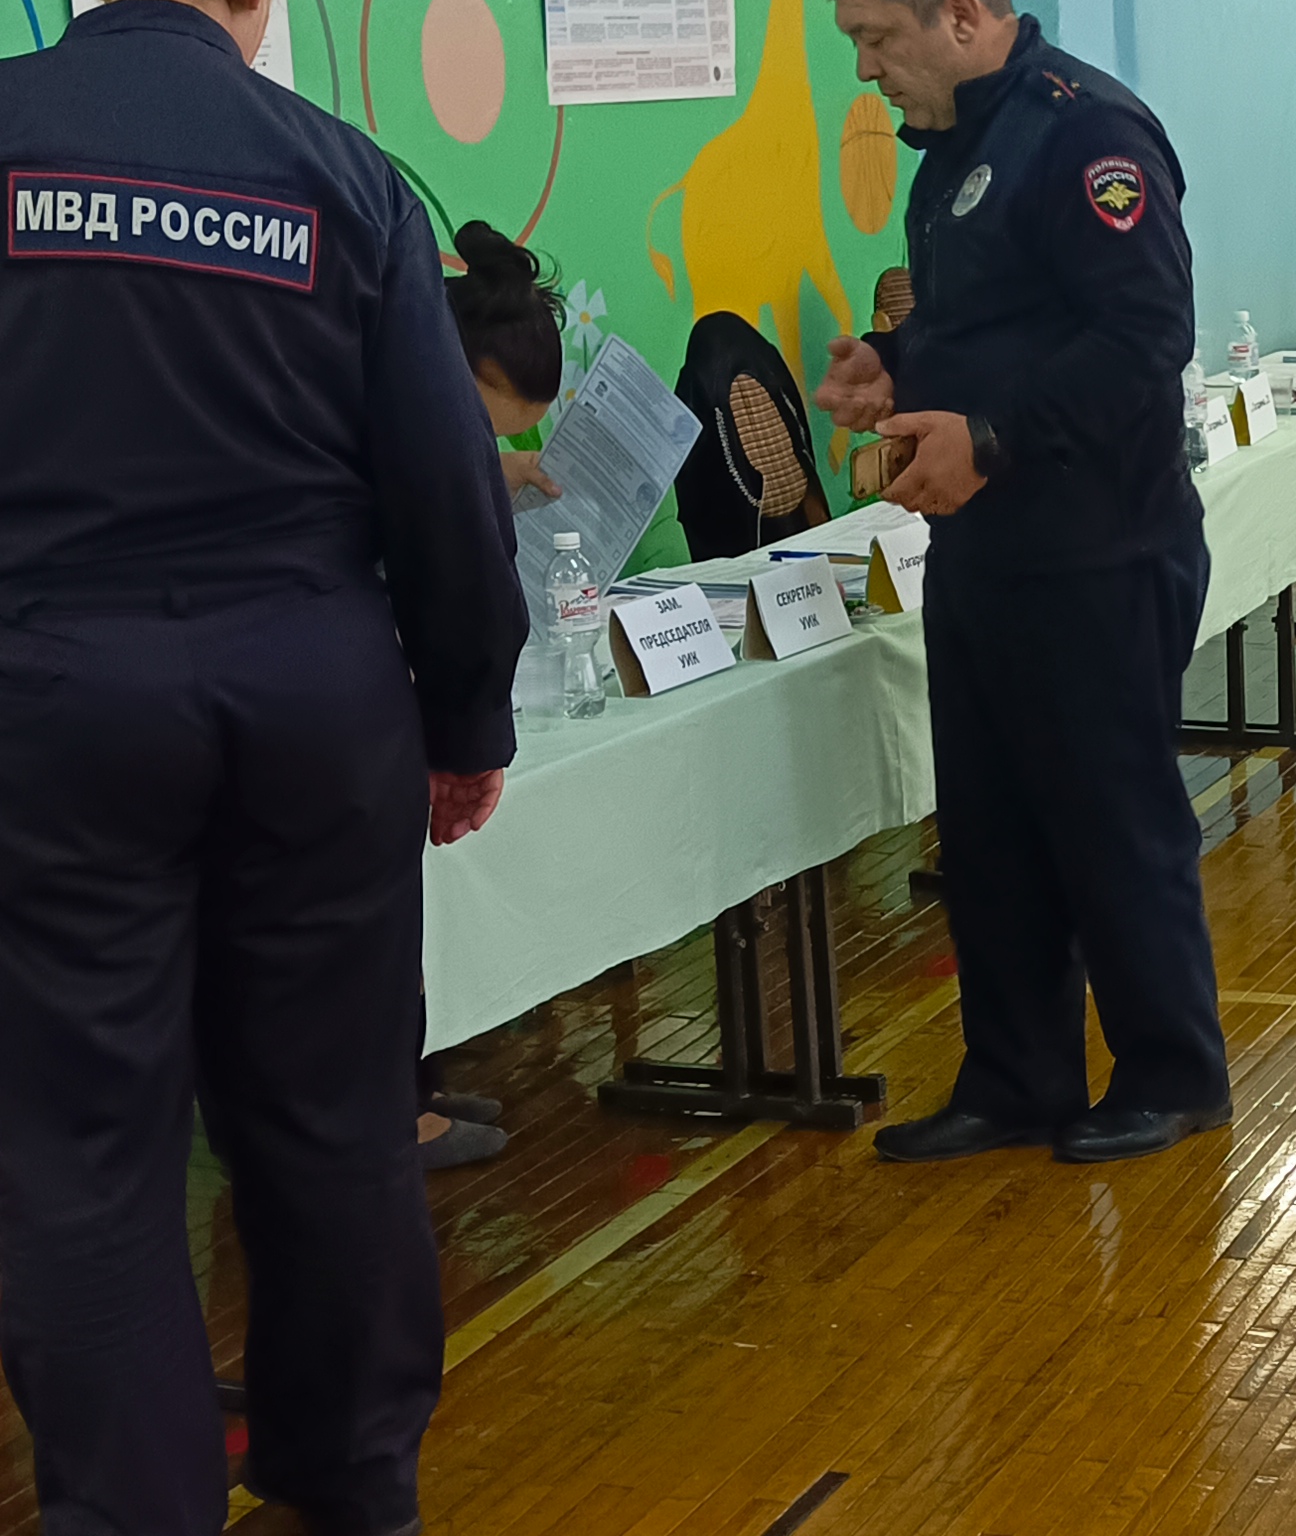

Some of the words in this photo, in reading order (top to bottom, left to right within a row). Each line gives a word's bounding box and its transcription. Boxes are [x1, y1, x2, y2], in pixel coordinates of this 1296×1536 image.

[16, 190, 119, 241] МВД
[131, 196, 309, 265] РОССИИ
[776, 582, 822, 607] СЕКРЕТАРЬ
[655, 597, 682, 614] ЗАМ.
[799, 614, 820, 630] УИК
[639, 618, 712, 651] ПРЕДСЕДАТЕЛЯ
[677, 651, 700, 669] УИК
